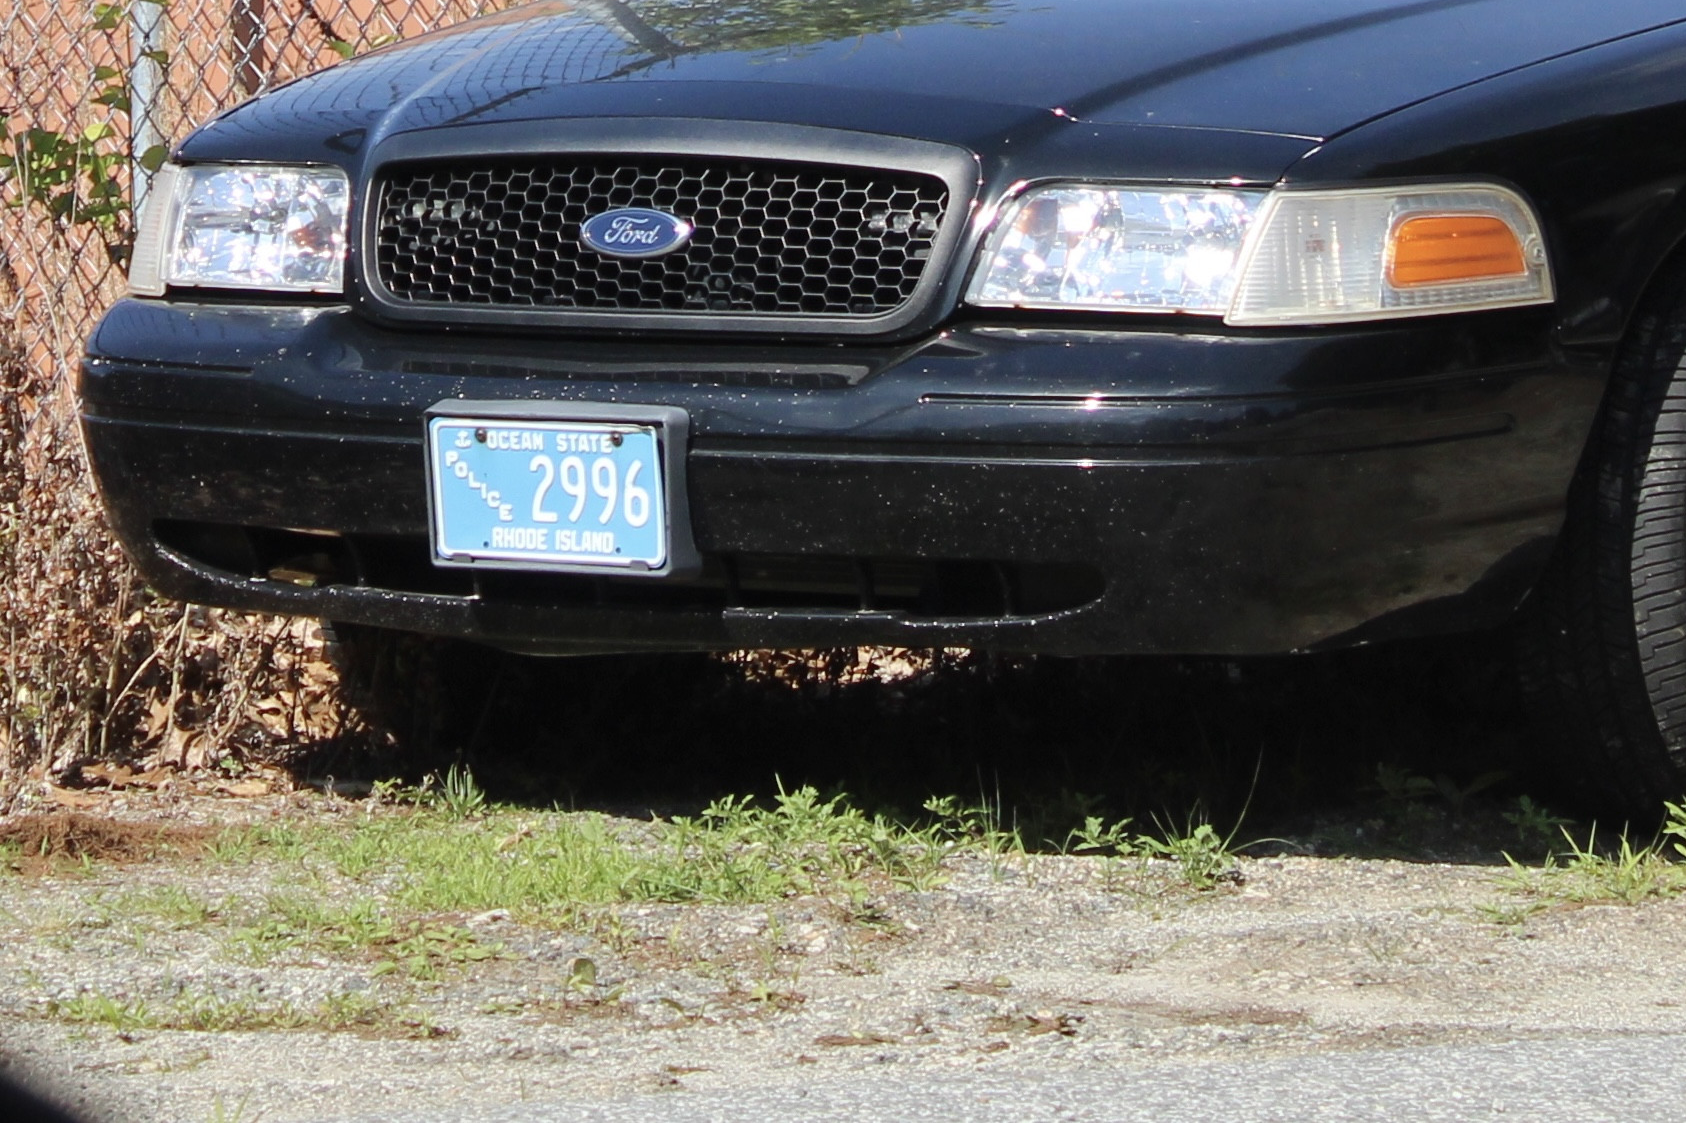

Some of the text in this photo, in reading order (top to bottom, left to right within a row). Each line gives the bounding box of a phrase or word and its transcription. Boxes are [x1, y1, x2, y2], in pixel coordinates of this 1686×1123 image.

[604, 216, 661, 244] Ford
[486, 431, 613, 454] OCEAN STATE
[445, 450, 514, 521] POLICE
[529, 454, 650, 528] 2996
[492, 526, 615, 554] RHODE ISLAND
